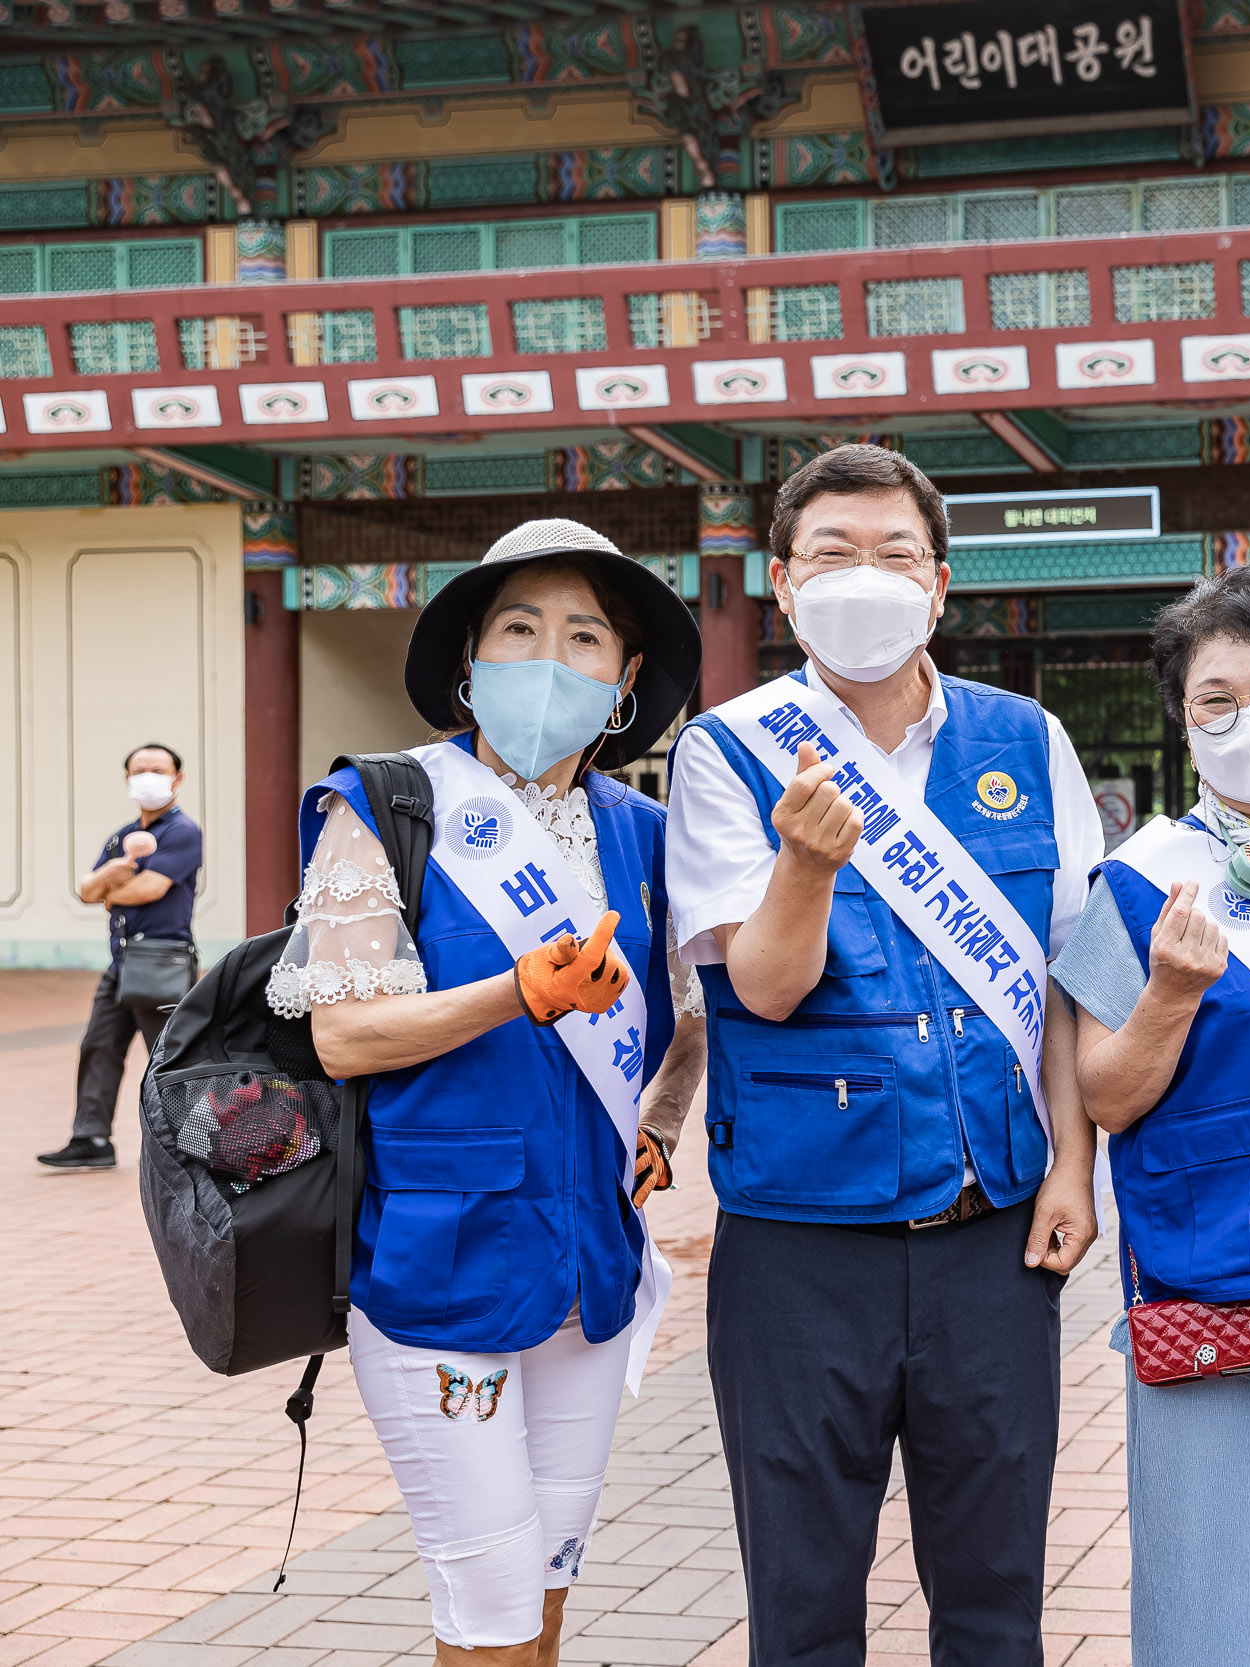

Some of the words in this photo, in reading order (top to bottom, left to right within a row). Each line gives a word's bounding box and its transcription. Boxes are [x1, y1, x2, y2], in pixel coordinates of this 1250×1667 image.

[901, 15, 1157, 91] 어린이대공원
[883, 830, 944, 893] 위한
[924, 879, 1021, 982] 기초질서
